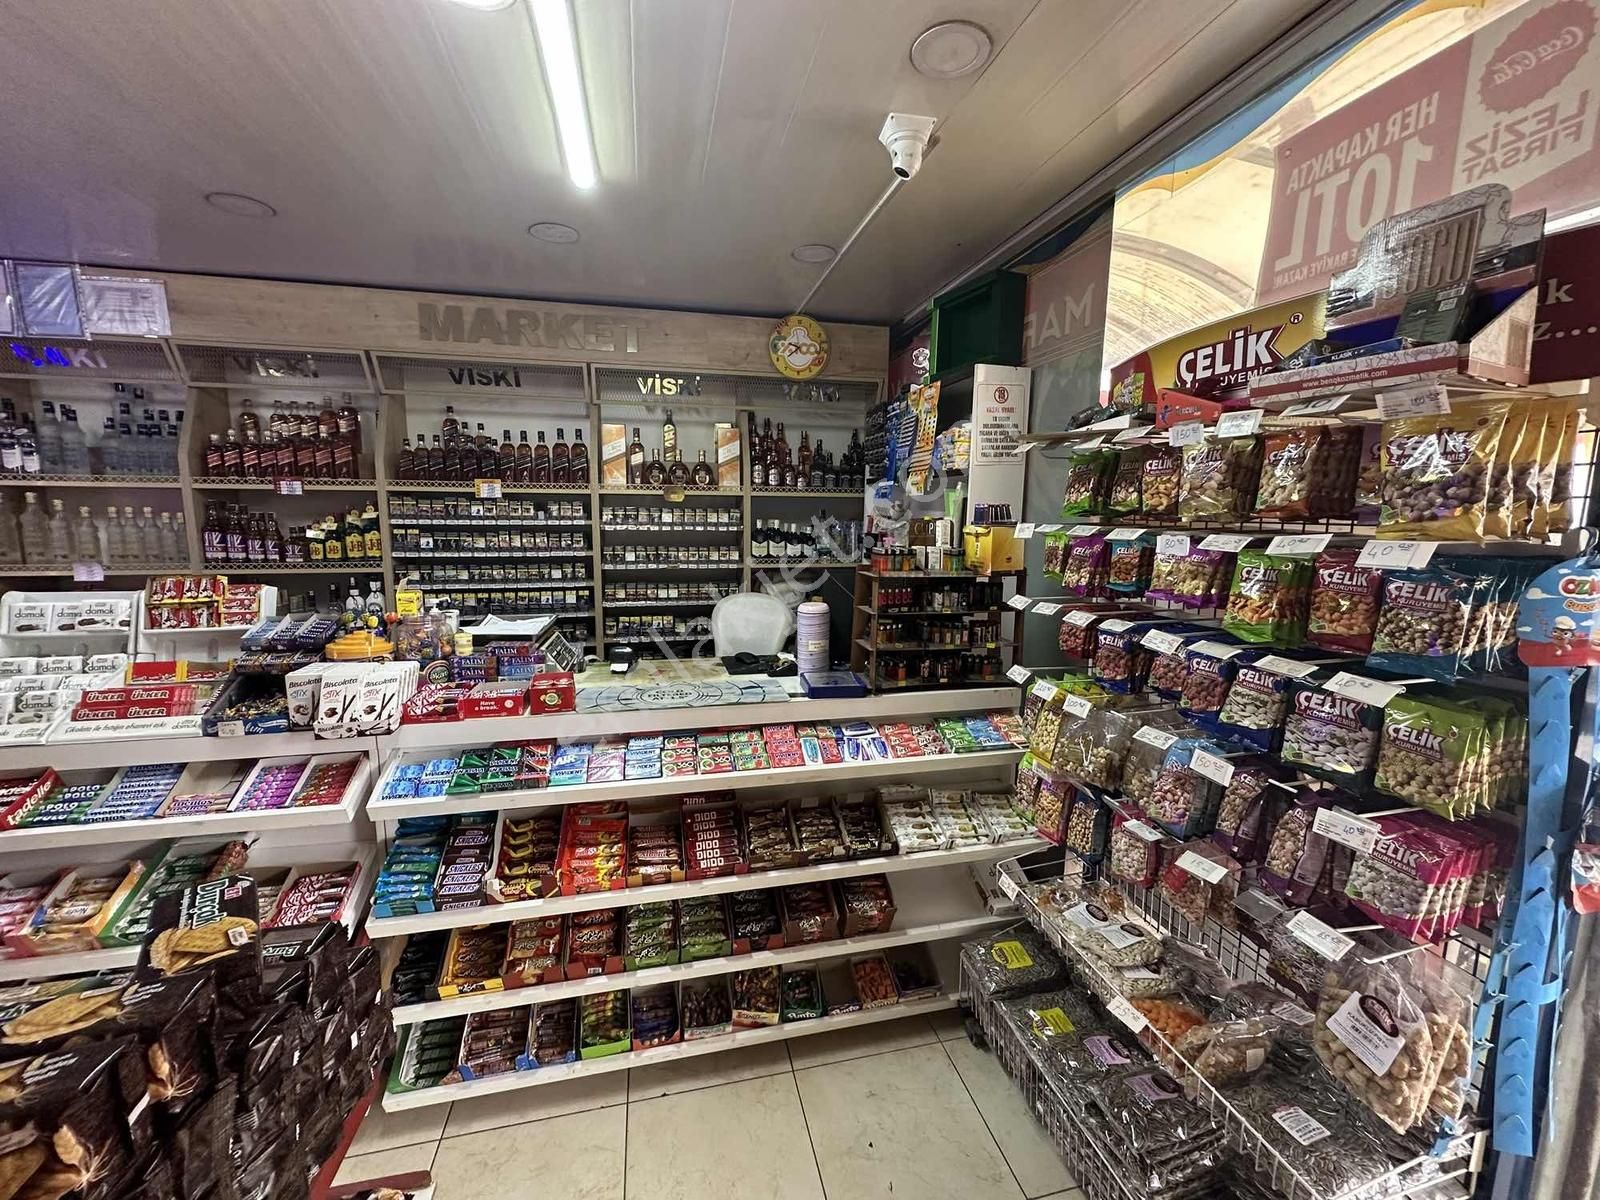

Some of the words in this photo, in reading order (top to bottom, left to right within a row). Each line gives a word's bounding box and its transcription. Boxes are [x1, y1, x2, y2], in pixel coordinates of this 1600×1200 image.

[418, 303, 648, 353] MARKET
[1179, 328, 1273, 388] ÇELİK
[1320, 569, 1368, 586] ÇELİK
[1388, 582, 1449, 603] ÇELİK
[1239, 669, 1273, 688] ÇELİK
[88, 693, 124, 702] ÜLKER
[131, 691, 168, 699] ÜLKER
[1299, 691, 1356, 719] ÇELİK
[78, 710, 115, 719] ÜLKER
[129, 708, 165, 717] ÜLKER
[1388, 724, 1446, 751] ÇELİK
[6, 781, 52, 826] tadelle
[44, 802, 78, 811] POLO
[456, 835, 488, 845] SNICKERS
[696, 840, 719, 850] DIDO
[697, 849, 720, 859] DIDO
[1375, 837, 1420, 868] ELİK
[447, 863, 482, 873] SNICKERS
[701, 857, 724, 868] DIDO
[444, 874, 481, 884] SNICKERS
[439, 884, 480, 895] SNICKERS
[190, 878, 229, 929] Burçak
[443, 900, 481, 910] SNICKERS
